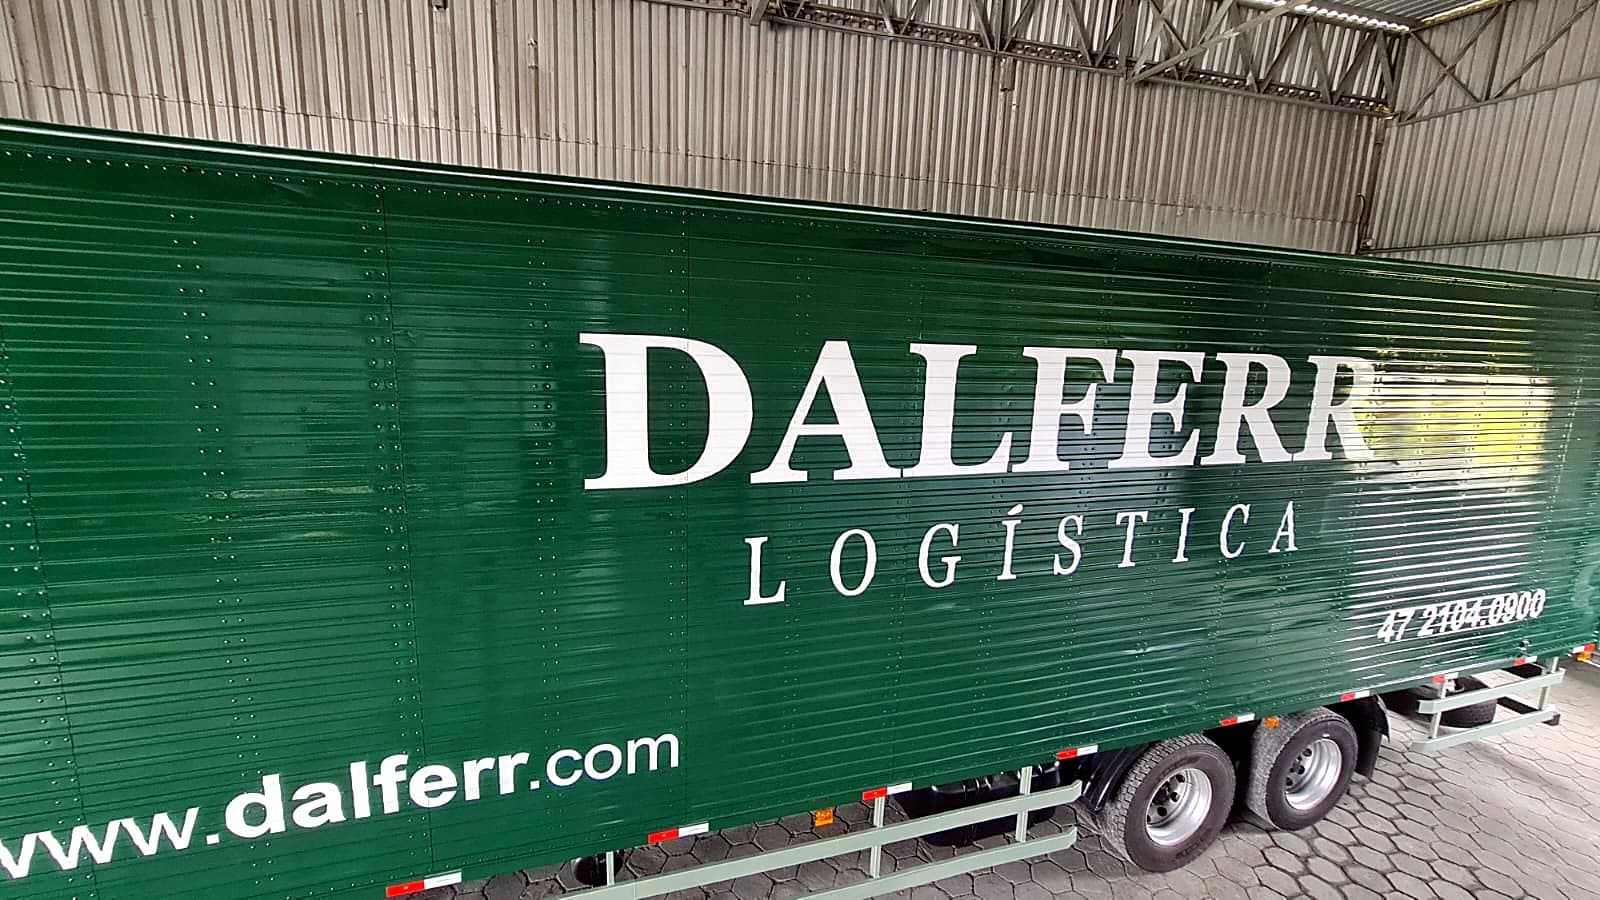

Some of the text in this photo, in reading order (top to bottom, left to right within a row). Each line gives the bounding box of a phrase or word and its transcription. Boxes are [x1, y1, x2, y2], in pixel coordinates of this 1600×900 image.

[579, 332, 1375, 491] DALFERR
[743, 501, 1299, 606] LOGÍSTICA
[1377, 588, 1546, 642] 47 2104.0900
